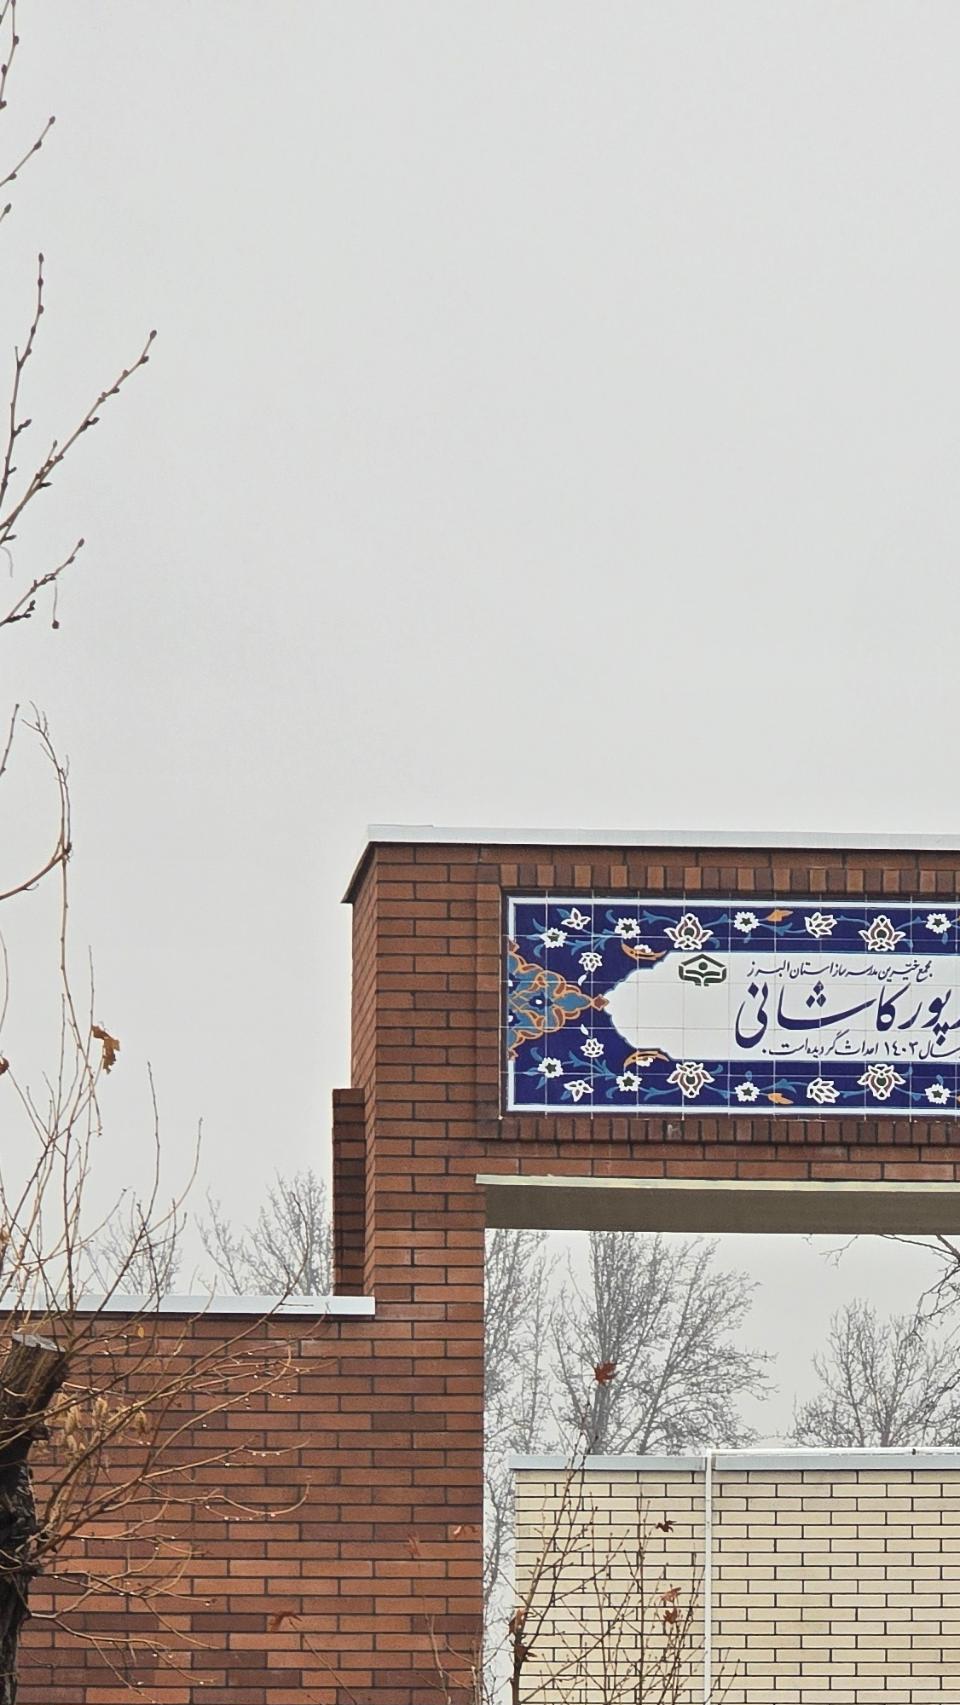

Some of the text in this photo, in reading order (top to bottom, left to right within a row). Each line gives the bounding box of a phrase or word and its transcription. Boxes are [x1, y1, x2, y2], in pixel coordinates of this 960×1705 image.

[747, 959, 790, 977] البرز
[789, 962, 835, 979] استان
[845, 964, 878, 977] مدرسه
[916, 960, 933, 982] مجمع
[735, 980, 911, 1049] کاشانی
[898, 988, 952, 1047] پور
[807, 1029, 850, 1058] گردیده
[835, 1039, 879, 1057] احداث
